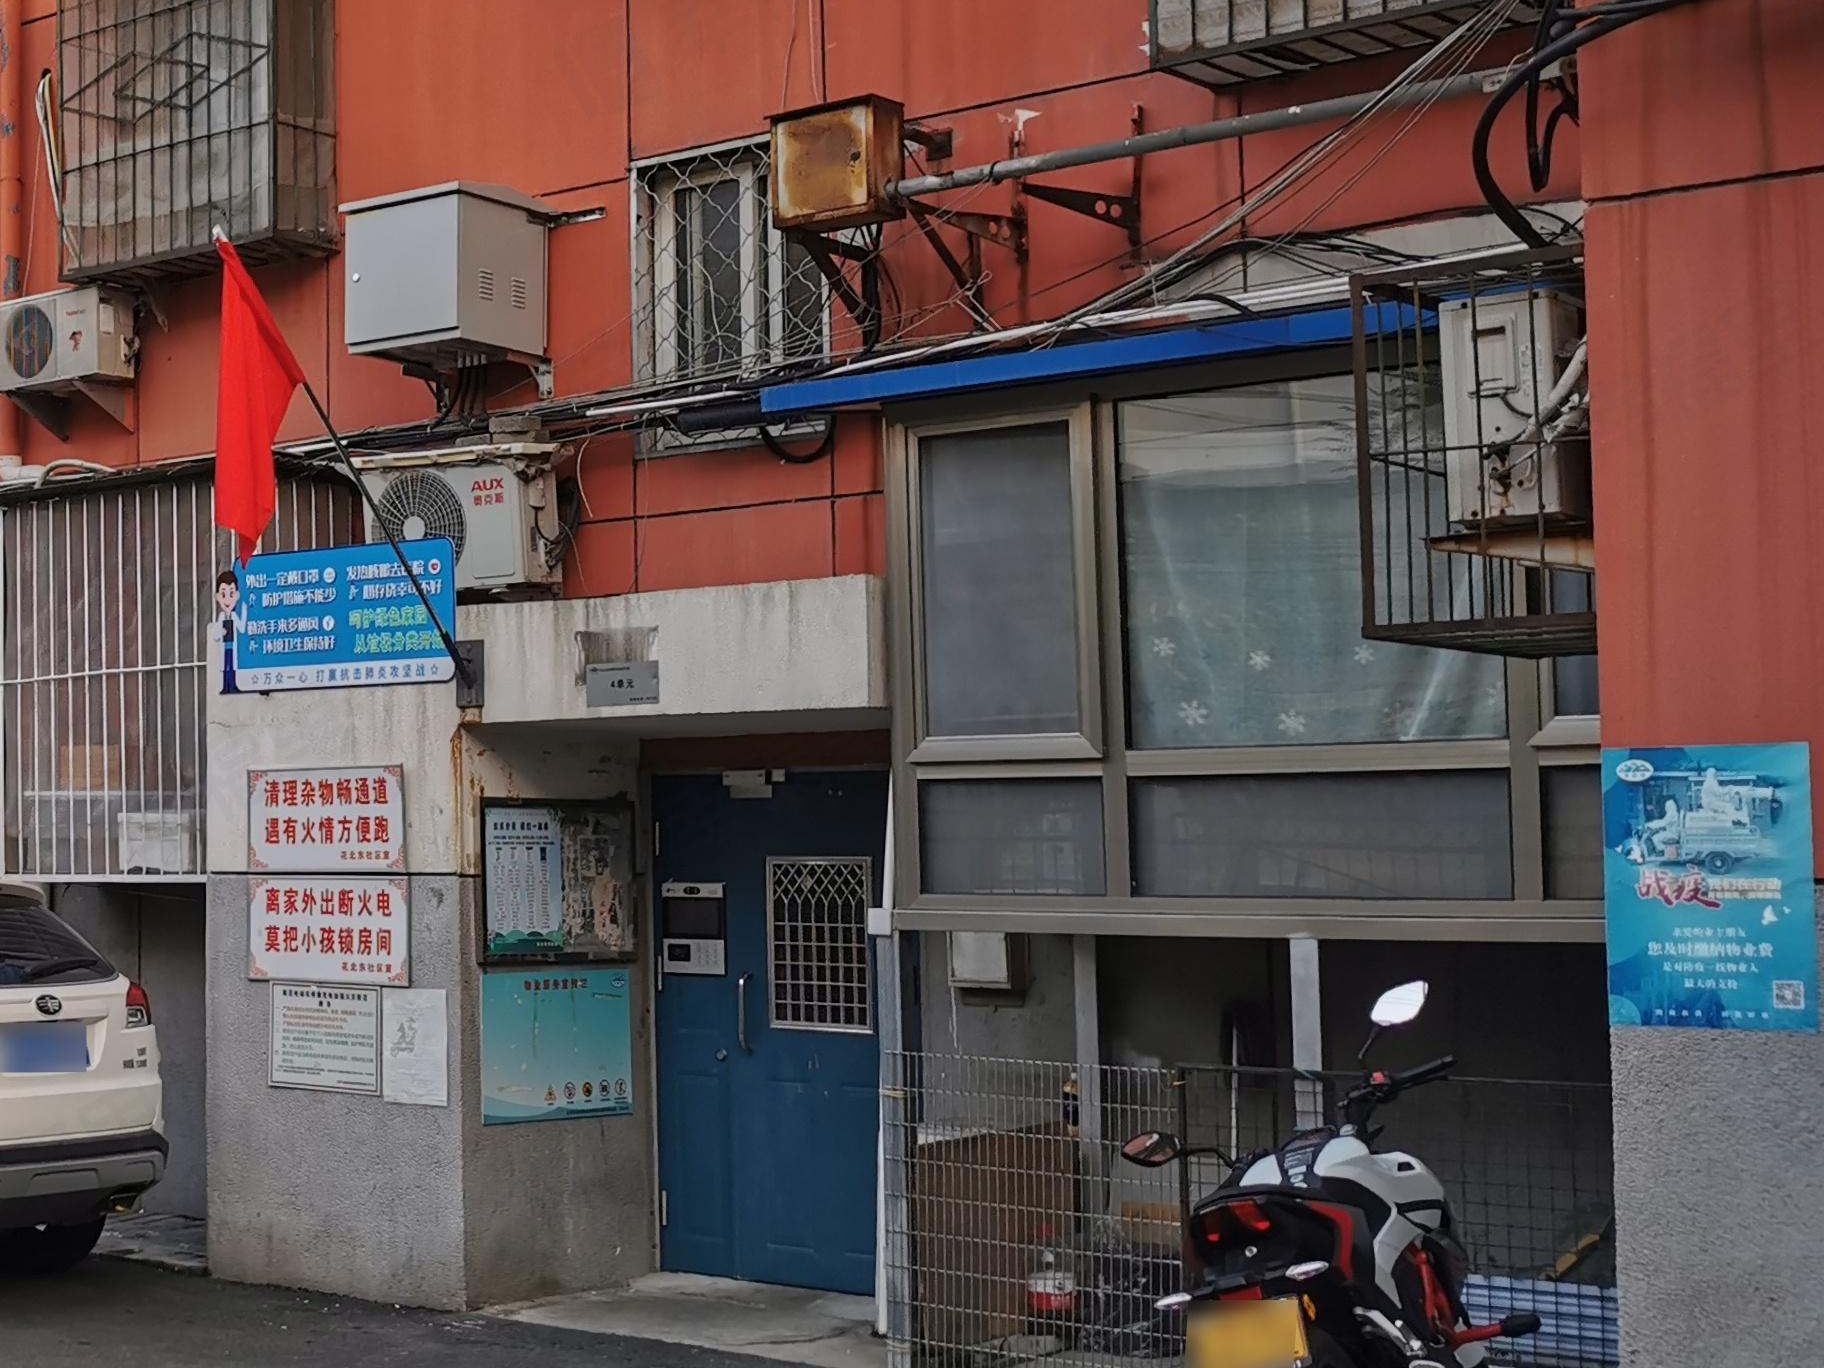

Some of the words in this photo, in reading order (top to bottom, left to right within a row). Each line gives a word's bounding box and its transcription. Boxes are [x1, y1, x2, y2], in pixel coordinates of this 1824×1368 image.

[471, 477, 504, 492] AUX
[349, 604, 429, 630] 呵护绿色家园
[264, 776, 388, 807] 清理杂物畅通道
[265, 815, 390, 844] 遇有火情方便跑
[265, 887, 392, 917] 离家外出断火电
[265, 925, 392, 955] 莫把小孩锁房间
